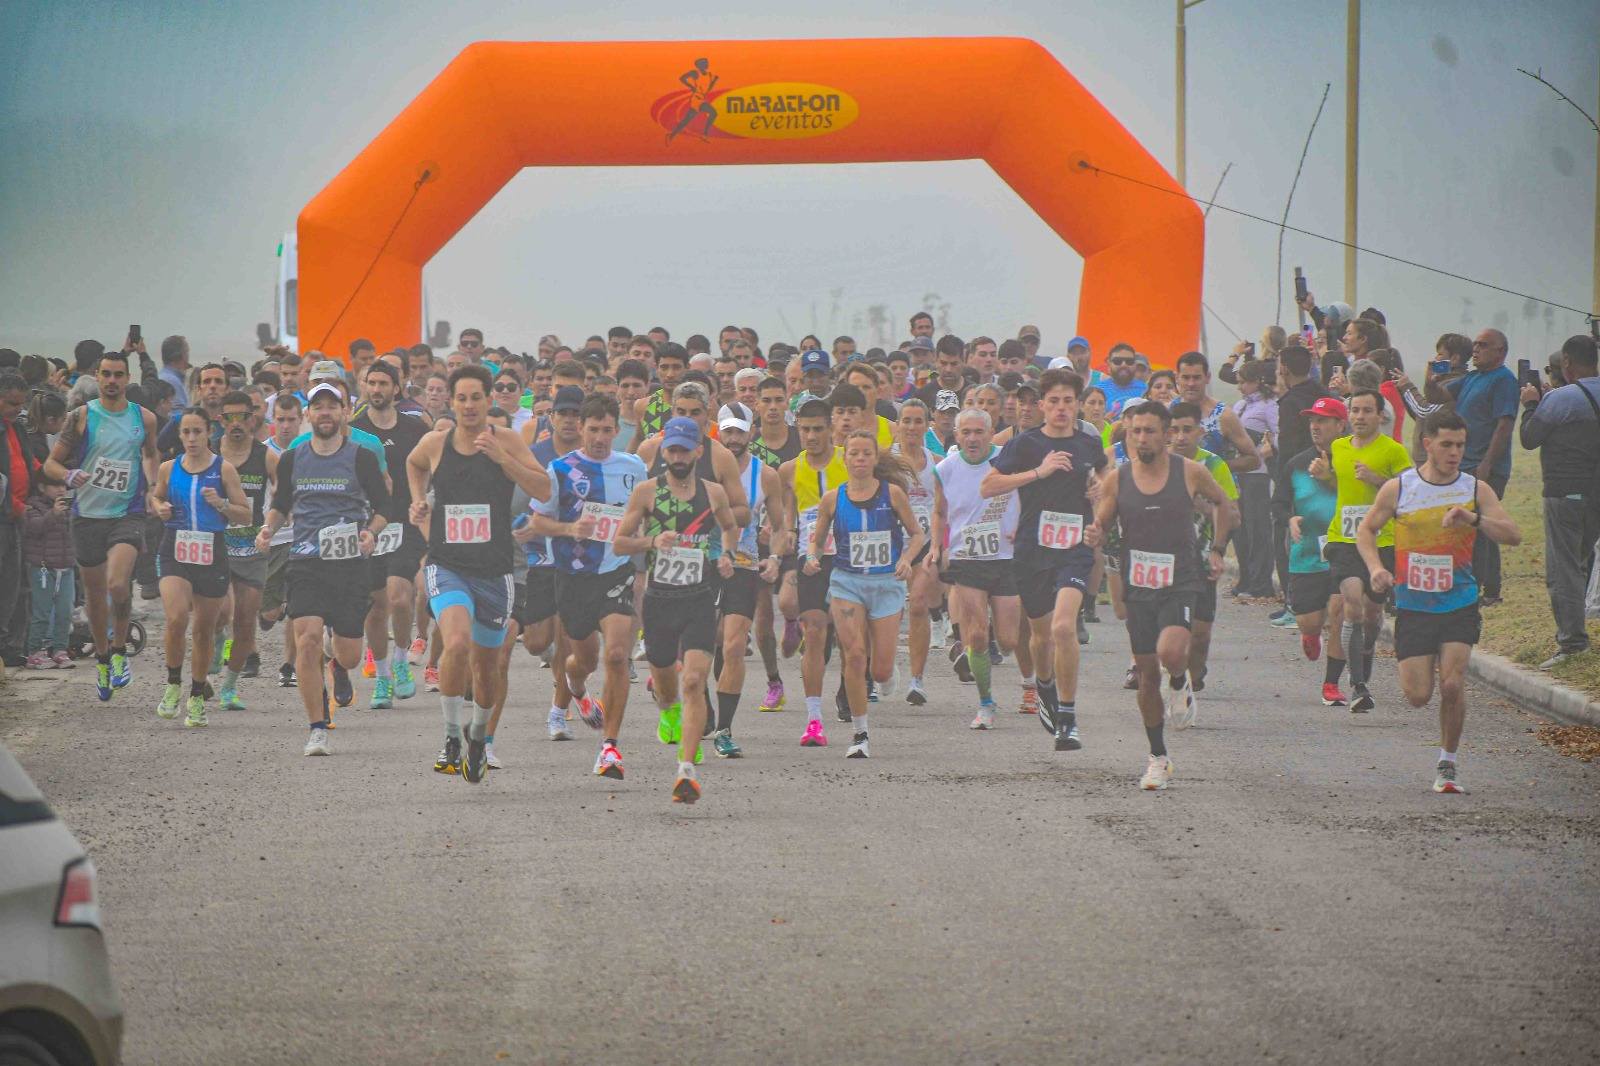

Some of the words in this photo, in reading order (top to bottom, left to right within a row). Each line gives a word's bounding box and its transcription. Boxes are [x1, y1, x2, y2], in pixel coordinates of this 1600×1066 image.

[726, 95, 841, 113] MARATHON
[750, 112, 833, 130] eventos
[92, 467, 128, 491] 225
[447, 517, 490, 541] 804
[1042, 524, 1080, 546] 647
[177, 541, 212, 564] 685
[321, 535, 358, 558] 238
[852, 543, 890, 565] 248
[965, 533, 1000, 556] 216
[656, 558, 700, 584] 223
[1134, 562, 1169, 588] 641
[1409, 566, 1452, 591] 635
